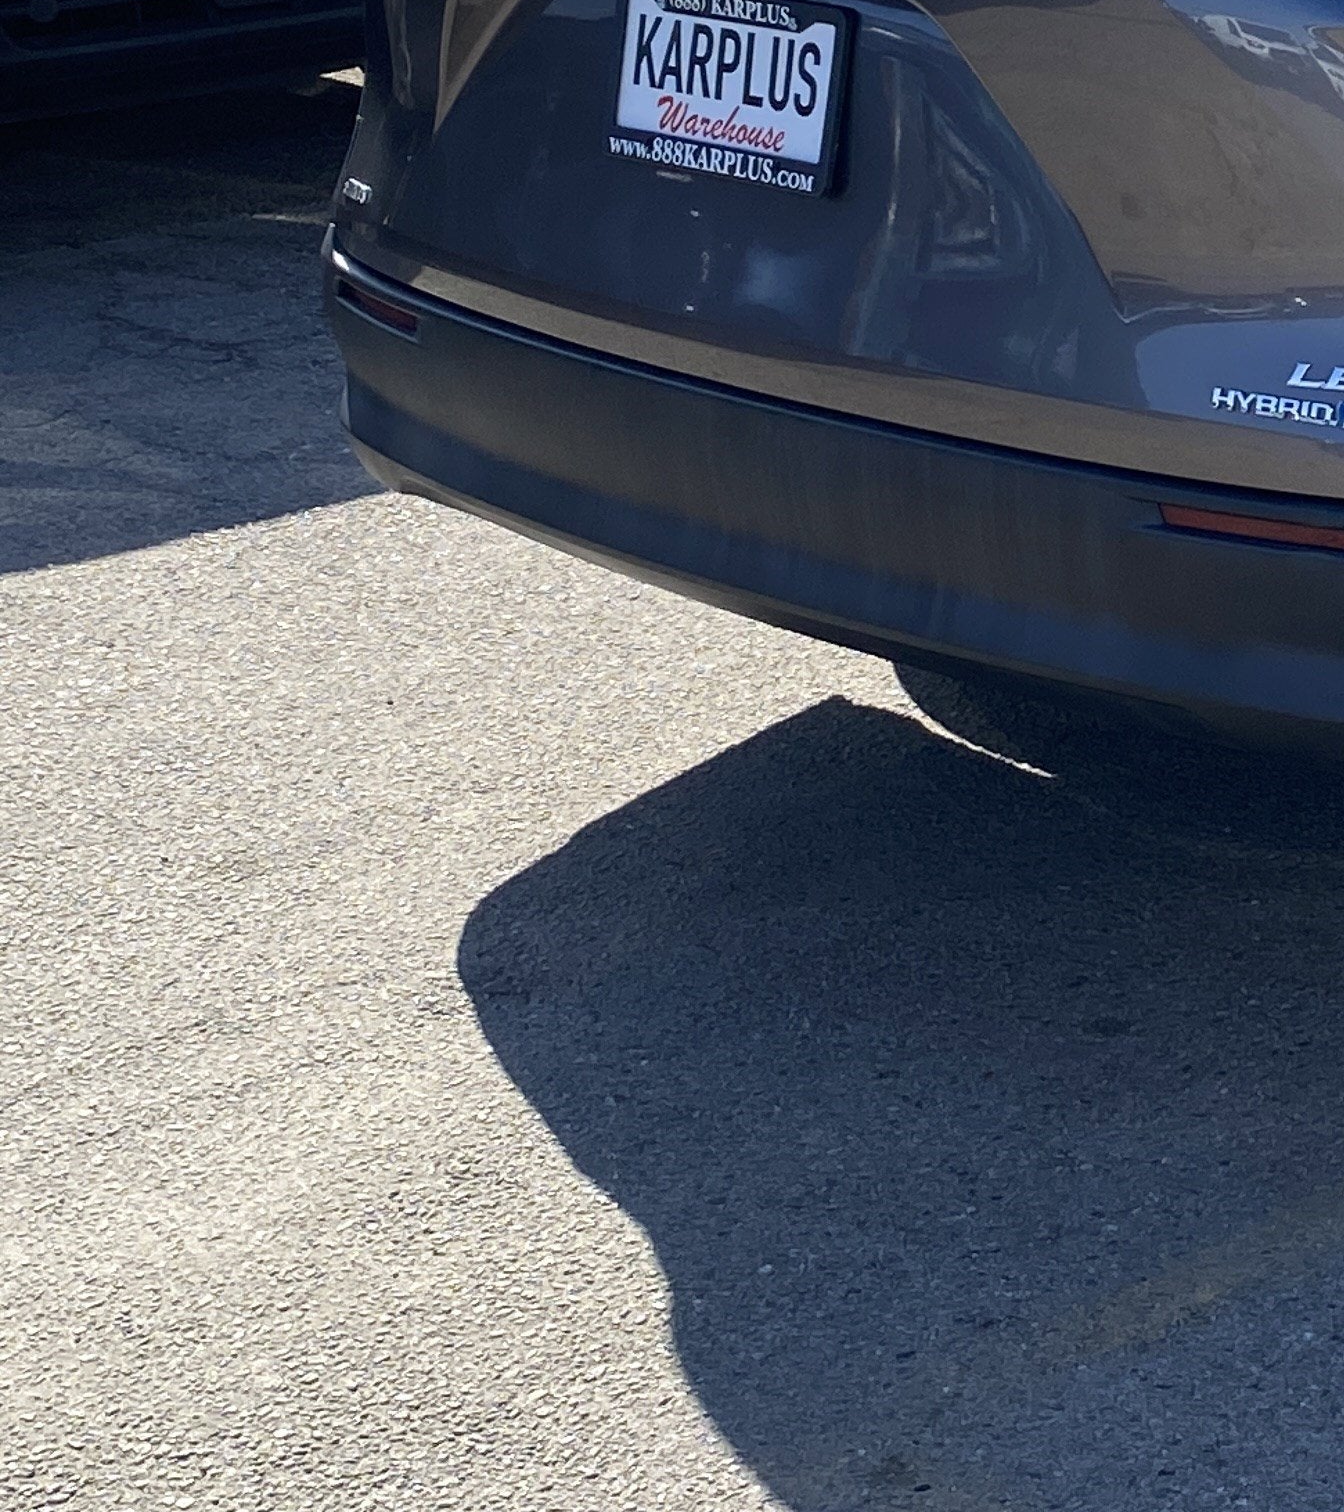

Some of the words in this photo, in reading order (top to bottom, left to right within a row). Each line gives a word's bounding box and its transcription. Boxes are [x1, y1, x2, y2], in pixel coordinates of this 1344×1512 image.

[632, 12, 822, 118] KARPLUS
[656, 94, 786, 154] Warehouse
[1209, 386, 1339, 426] HYBRID
